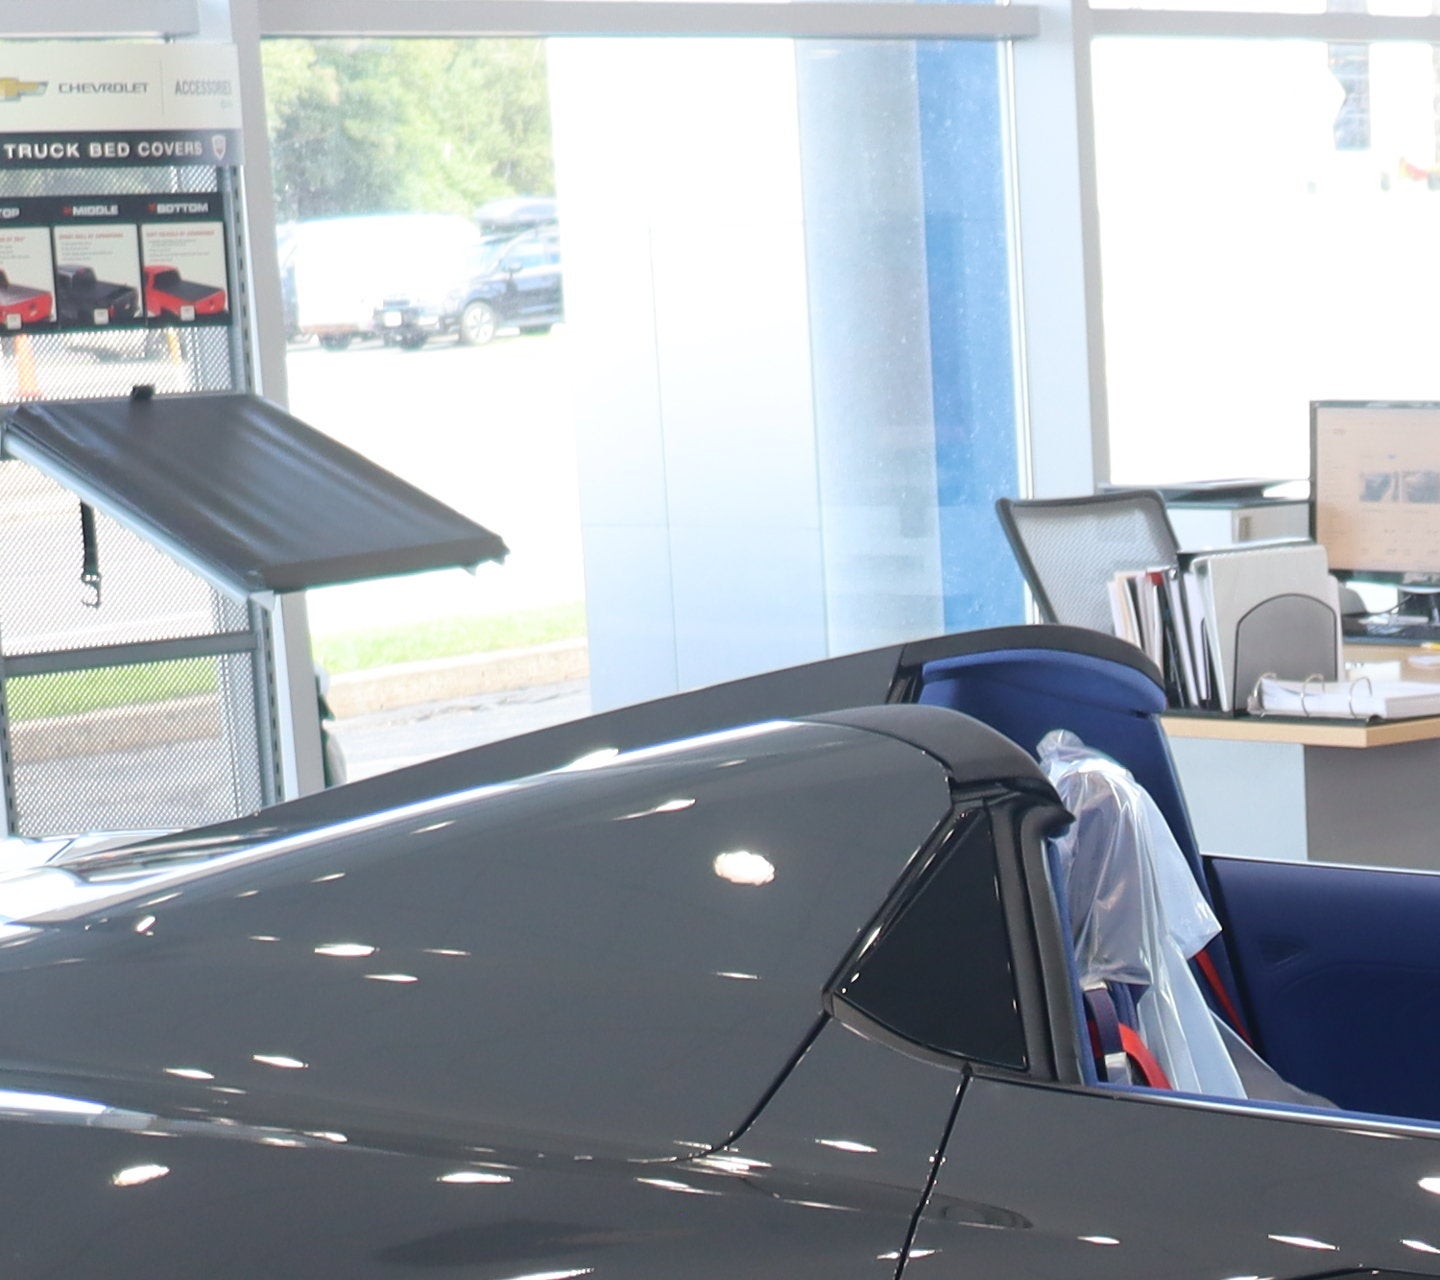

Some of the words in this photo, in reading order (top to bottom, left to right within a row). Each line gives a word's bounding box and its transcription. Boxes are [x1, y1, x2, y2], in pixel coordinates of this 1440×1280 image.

[58, 82, 149, 94] CHEVROLET
[4, 142, 80, 159] TRUCK
[89, 142, 130, 158] BED
[138, 140, 203, 157] COVERS
[72, 204, 119, 217] MIDDLE
[157, 203, 209, 214] BOTTOM
